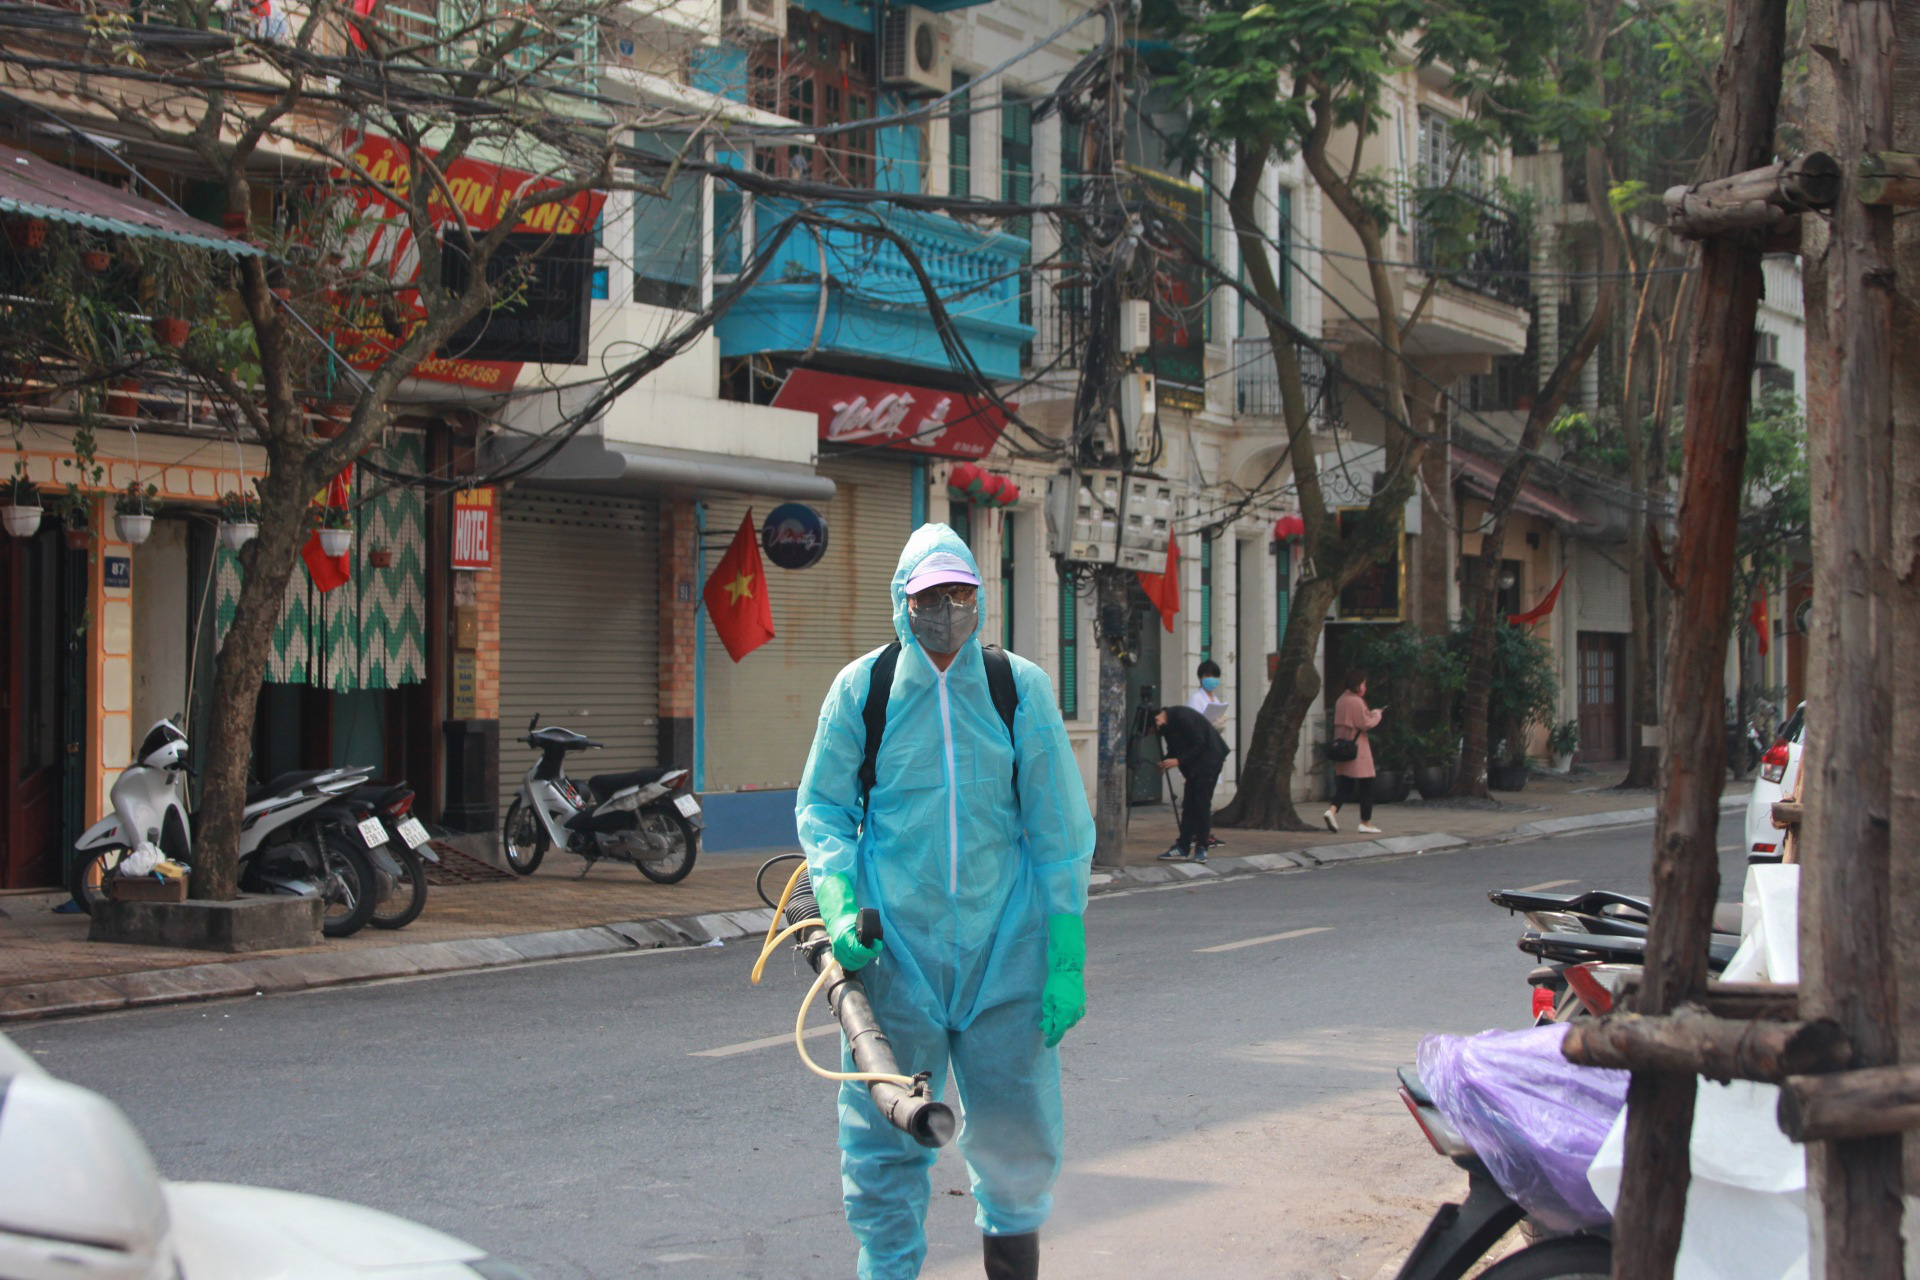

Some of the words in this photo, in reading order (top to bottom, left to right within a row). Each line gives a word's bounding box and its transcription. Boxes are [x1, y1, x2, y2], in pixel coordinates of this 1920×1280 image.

[428, 175, 493, 215] ƠN
[455, 509, 489, 562] HOTEL
[111, 562, 125, 576] 87
